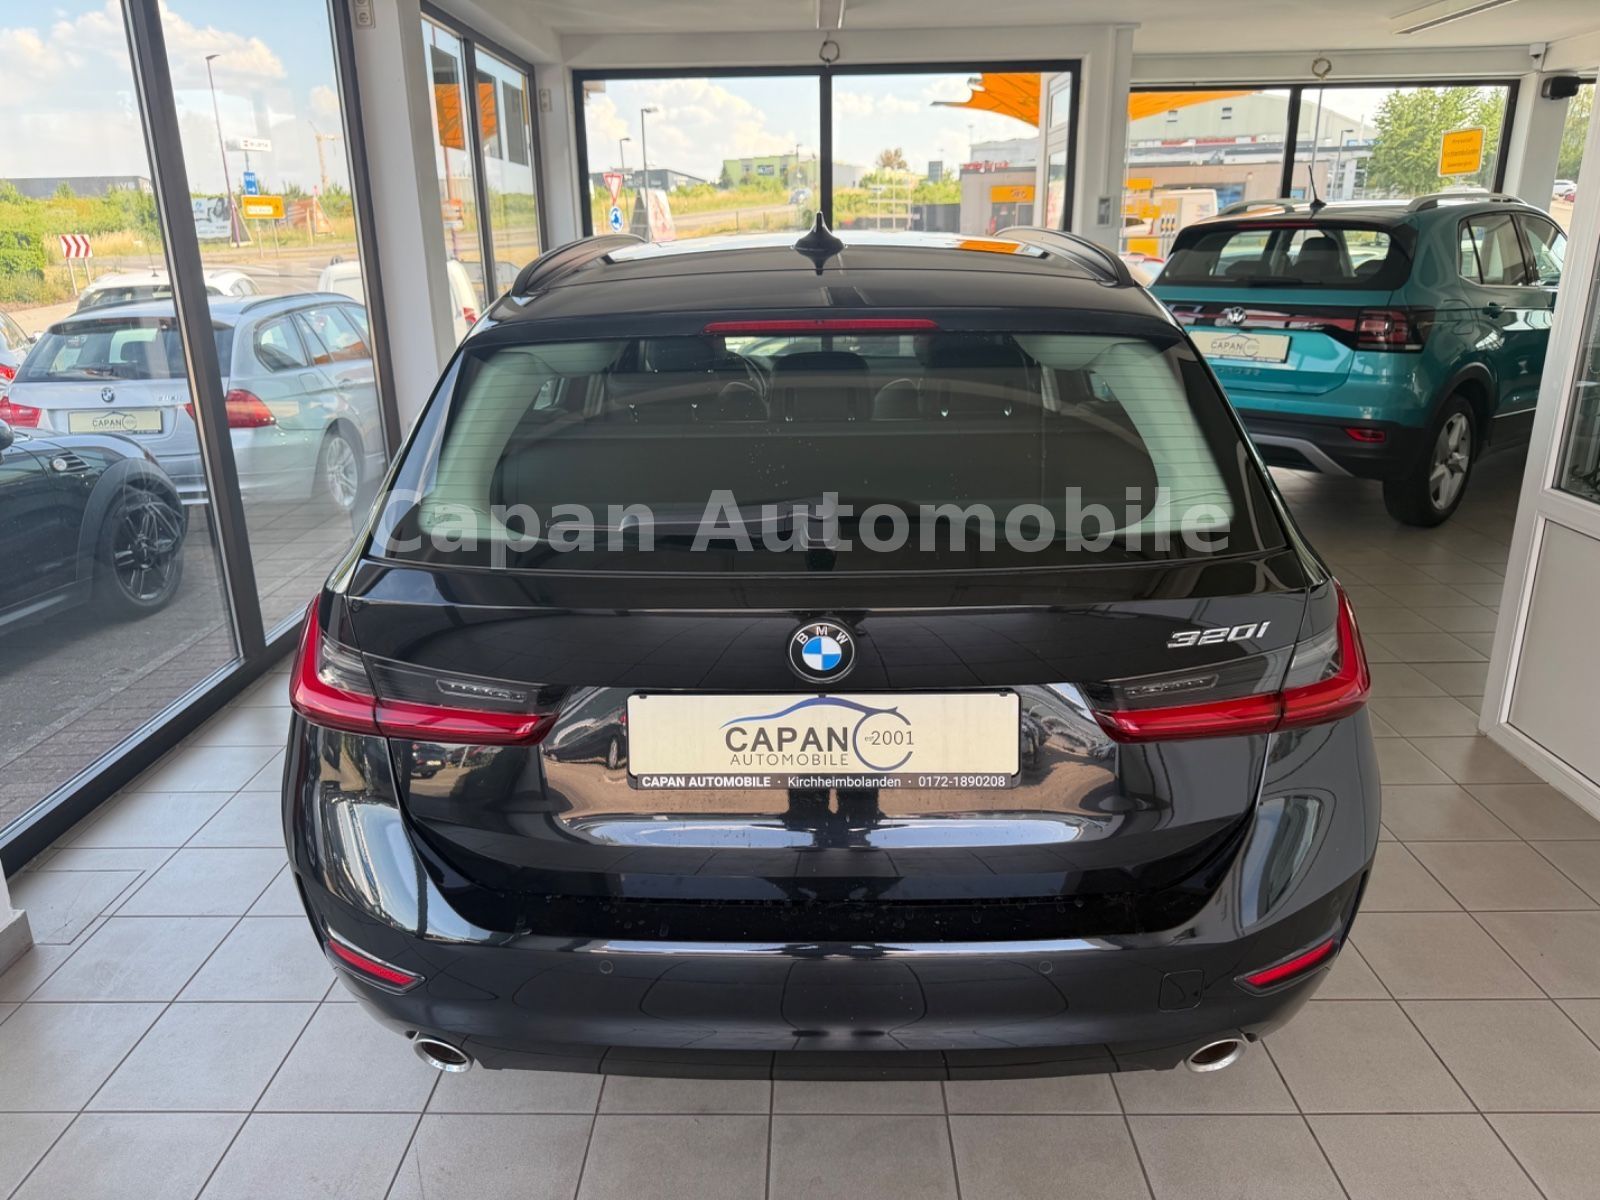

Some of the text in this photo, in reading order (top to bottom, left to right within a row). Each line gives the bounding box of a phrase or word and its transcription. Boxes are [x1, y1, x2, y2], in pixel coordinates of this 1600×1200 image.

[1211, 340, 1243, 351] CAPAN
[92, 418, 122, 427] CAPAN
[796, 625, 849, 645] BMW
[725, 726, 848, 752] CAPAN
[871, 730, 914, 746] 2001
[730, 753, 849, 766] AUTOMOBILE
[641, 775, 1006, 788] CAPAN AUTOMOBILE Kirchheimbolanden 0172-1890208
